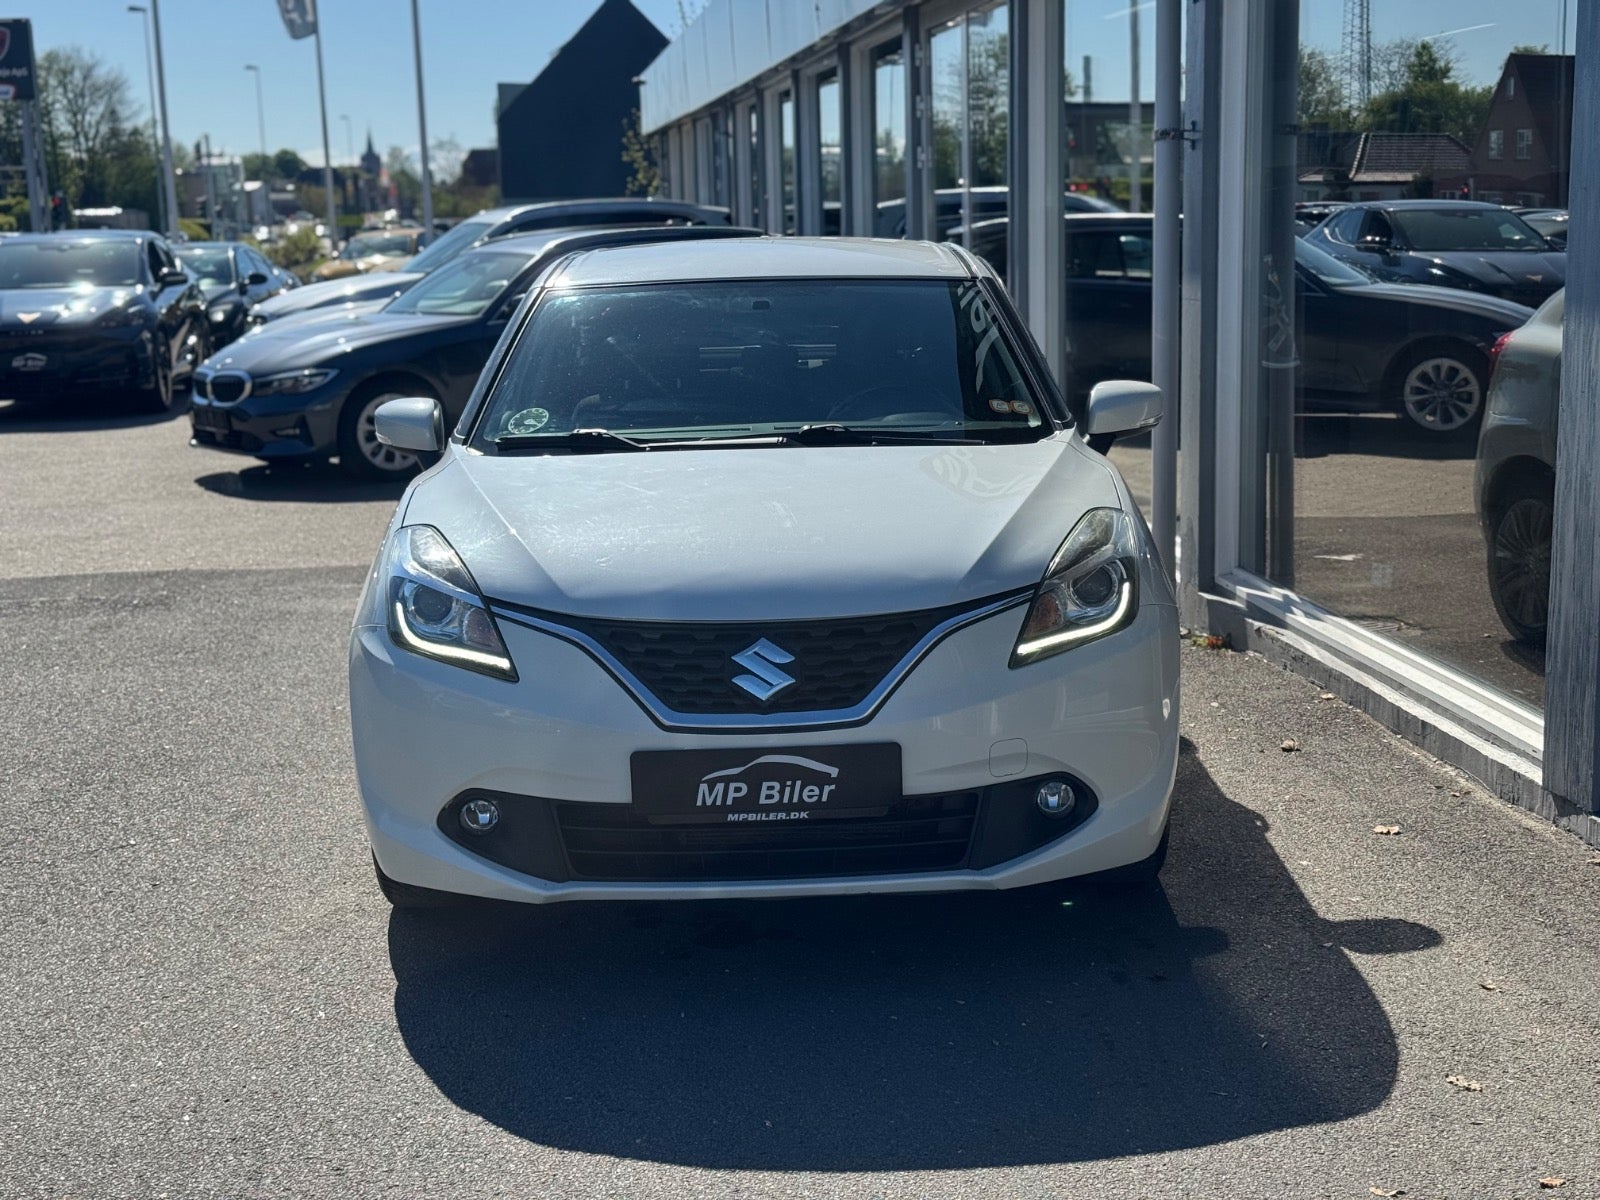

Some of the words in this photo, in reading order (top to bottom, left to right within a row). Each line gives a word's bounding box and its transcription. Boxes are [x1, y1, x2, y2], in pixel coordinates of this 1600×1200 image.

[696, 782, 748, 806] MP
[758, 779, 836, 805] Biler
[727, 810, 809, 822] MPBILER.DK
